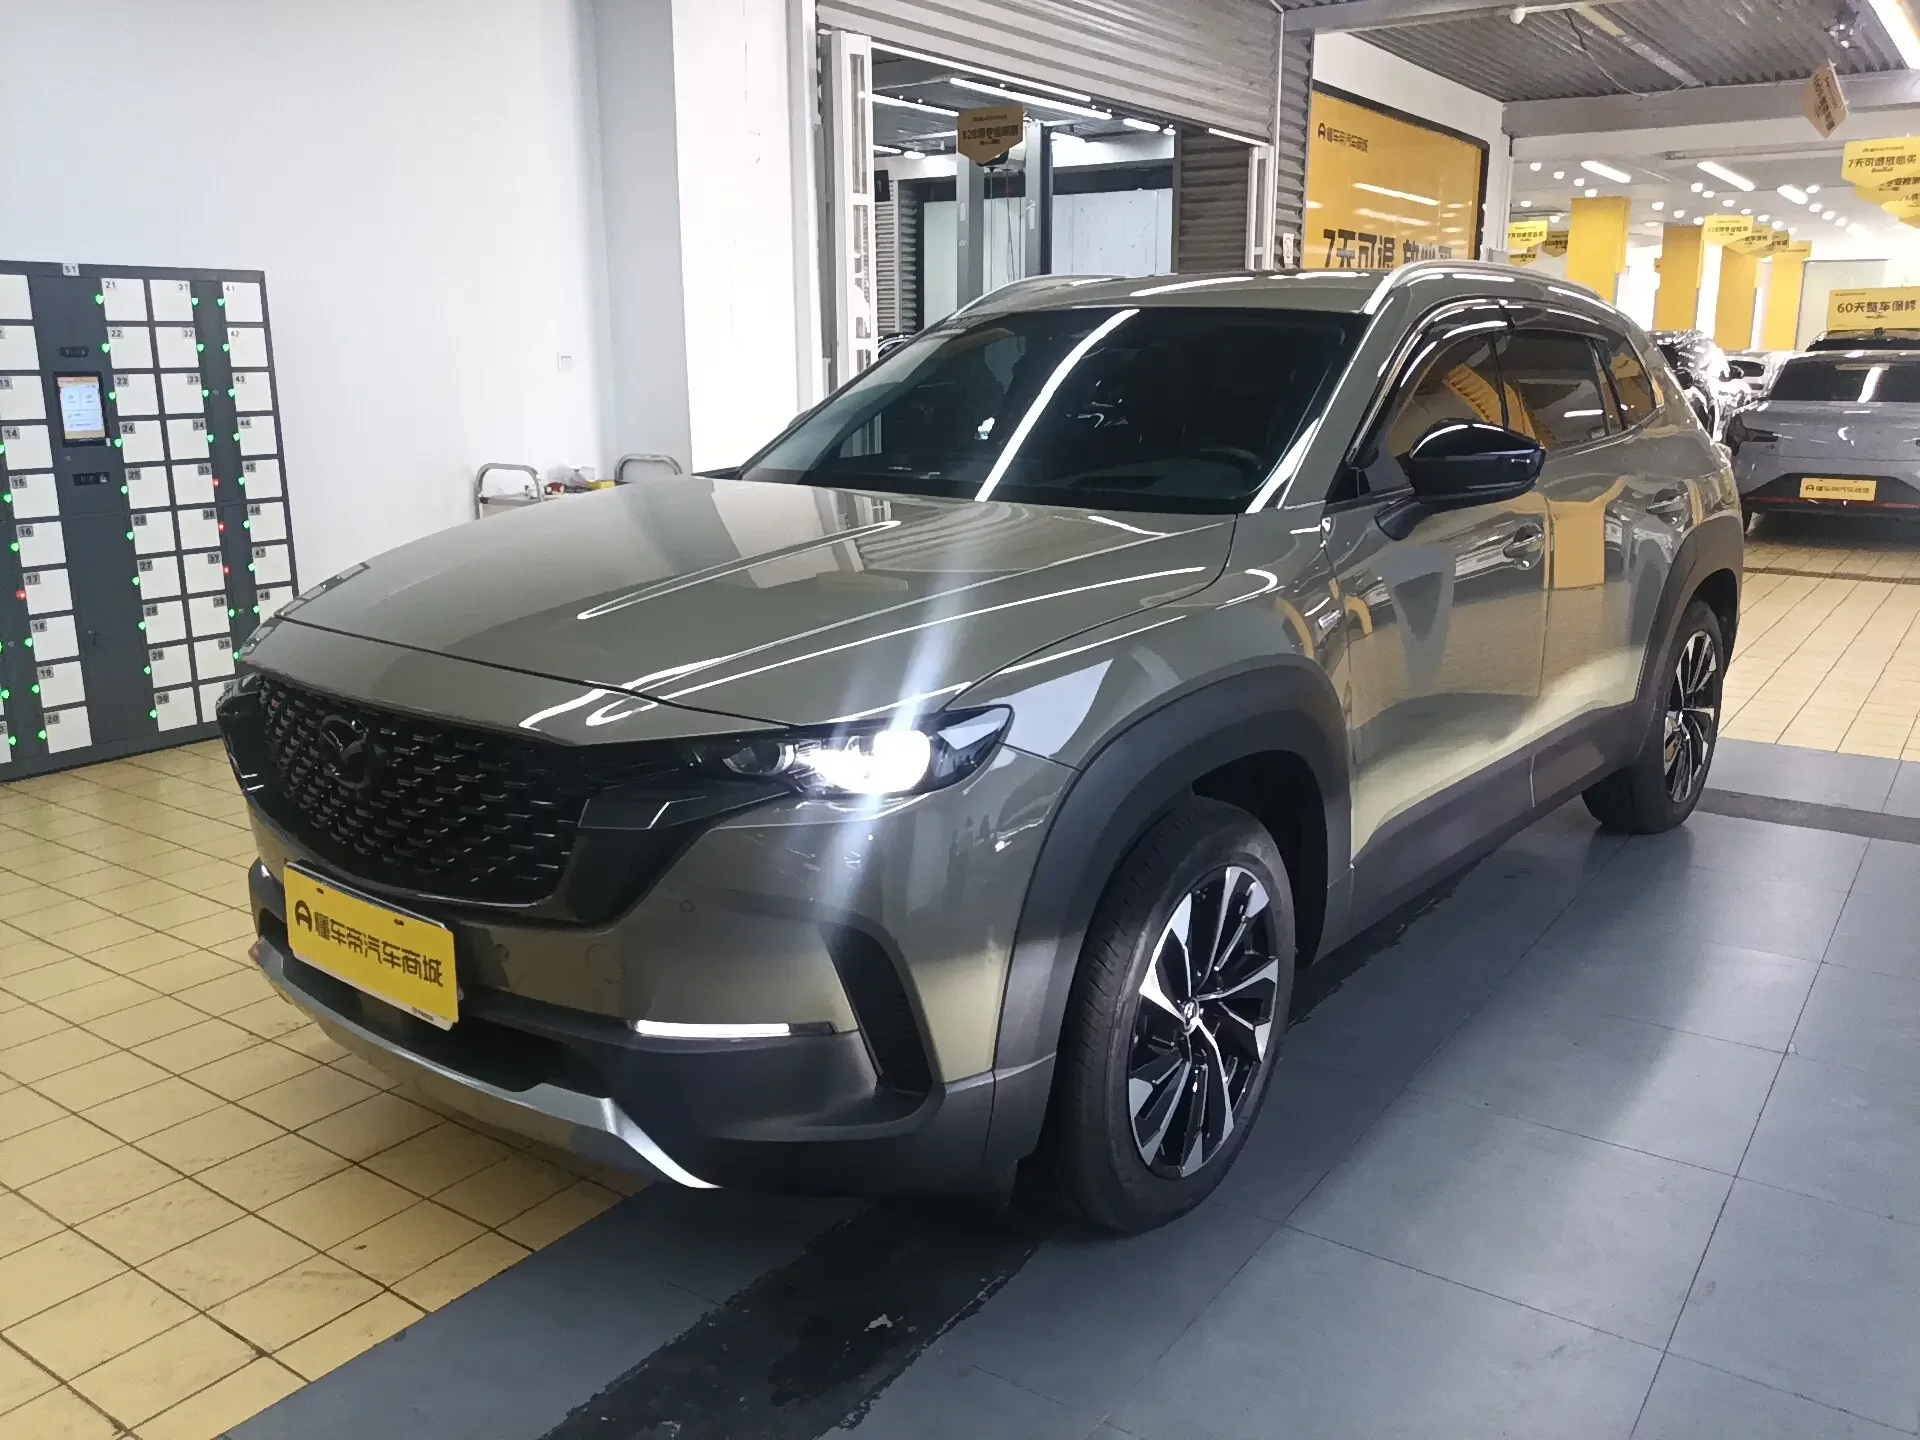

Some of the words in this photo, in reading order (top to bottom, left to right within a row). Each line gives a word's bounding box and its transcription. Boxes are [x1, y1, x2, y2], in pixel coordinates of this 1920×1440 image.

[106, 281, 116, 289] 21
[1837, 299, 1917, 313] 60天整车保修
[183, 330, 193, 338] 32
[4, 429, 17, 437] 14
[129, 471, 140, 479] 25
[20, 527, 31, 535] 16
[140, 562, 152, 570] 27
[26, 575, 38, 583] 17
[40, 668, 51, 677] 19
[47, 715, 58, 723] 20
[314, 911, 443, 987] 懂车帝汽车商城
